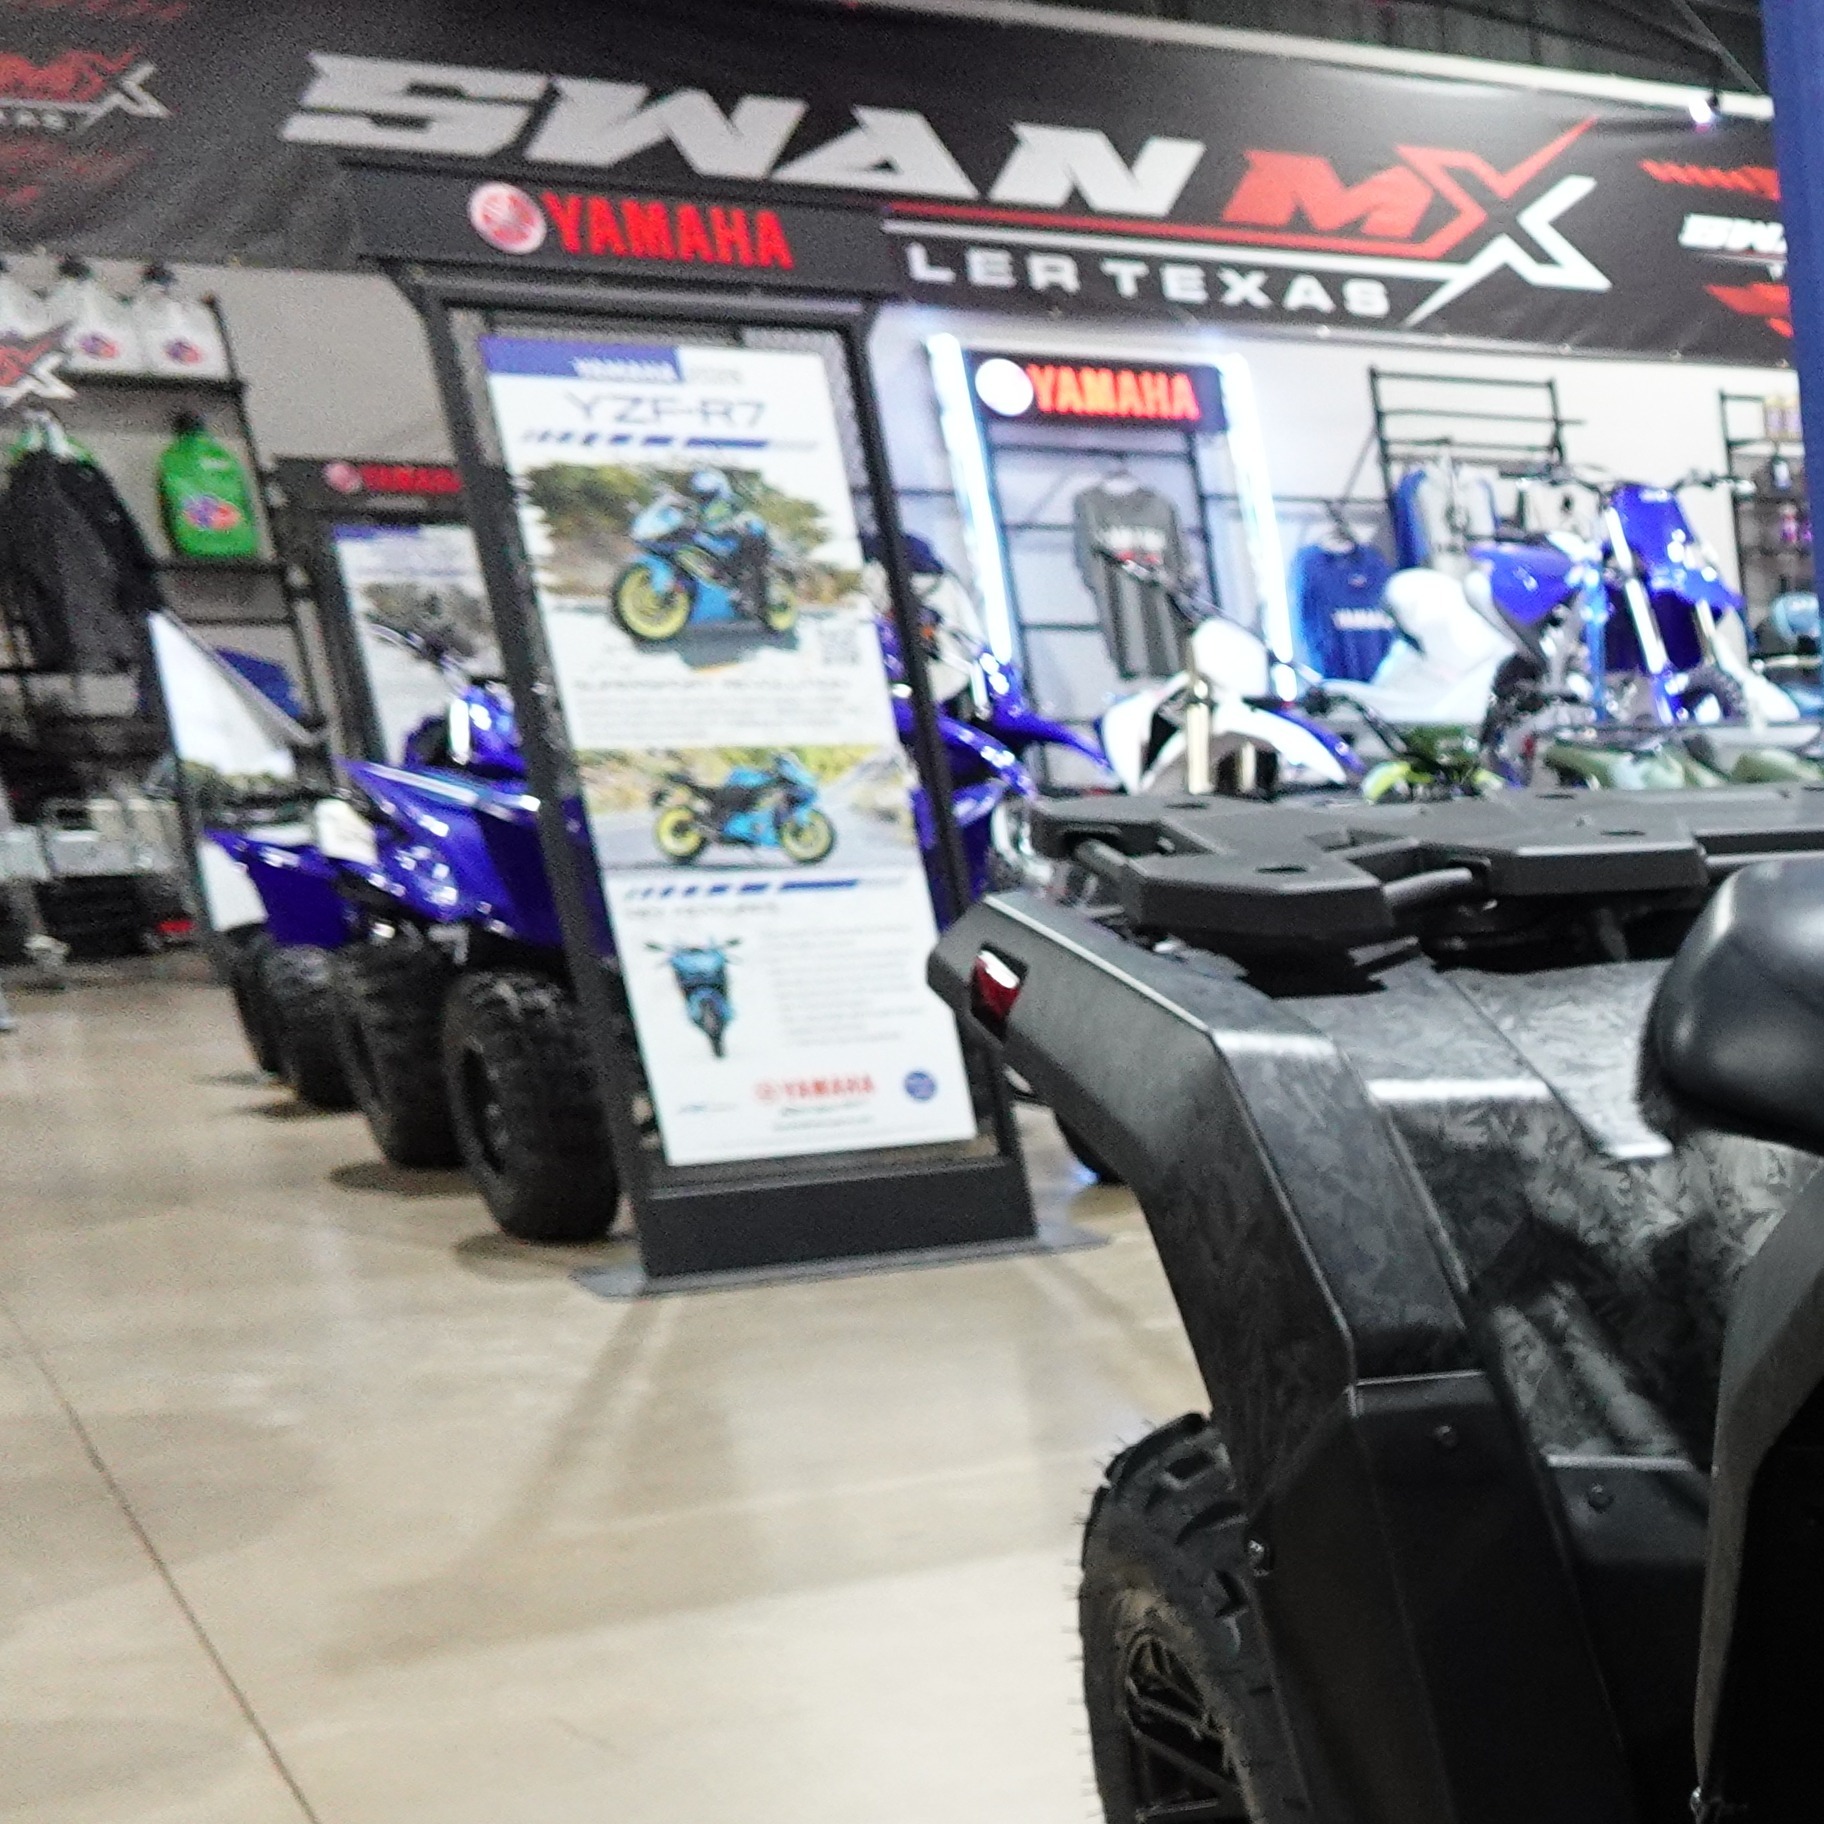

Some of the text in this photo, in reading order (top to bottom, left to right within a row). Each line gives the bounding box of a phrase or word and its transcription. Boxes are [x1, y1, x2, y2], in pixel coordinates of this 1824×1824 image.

[282, 52, 1611, 325] SWAN MX
[542, 192, 795, 270] YAMAHA
[906, 242, 1391, 317] LER TEXAS
[1024, 363, 1200, 421] YAMAHA
